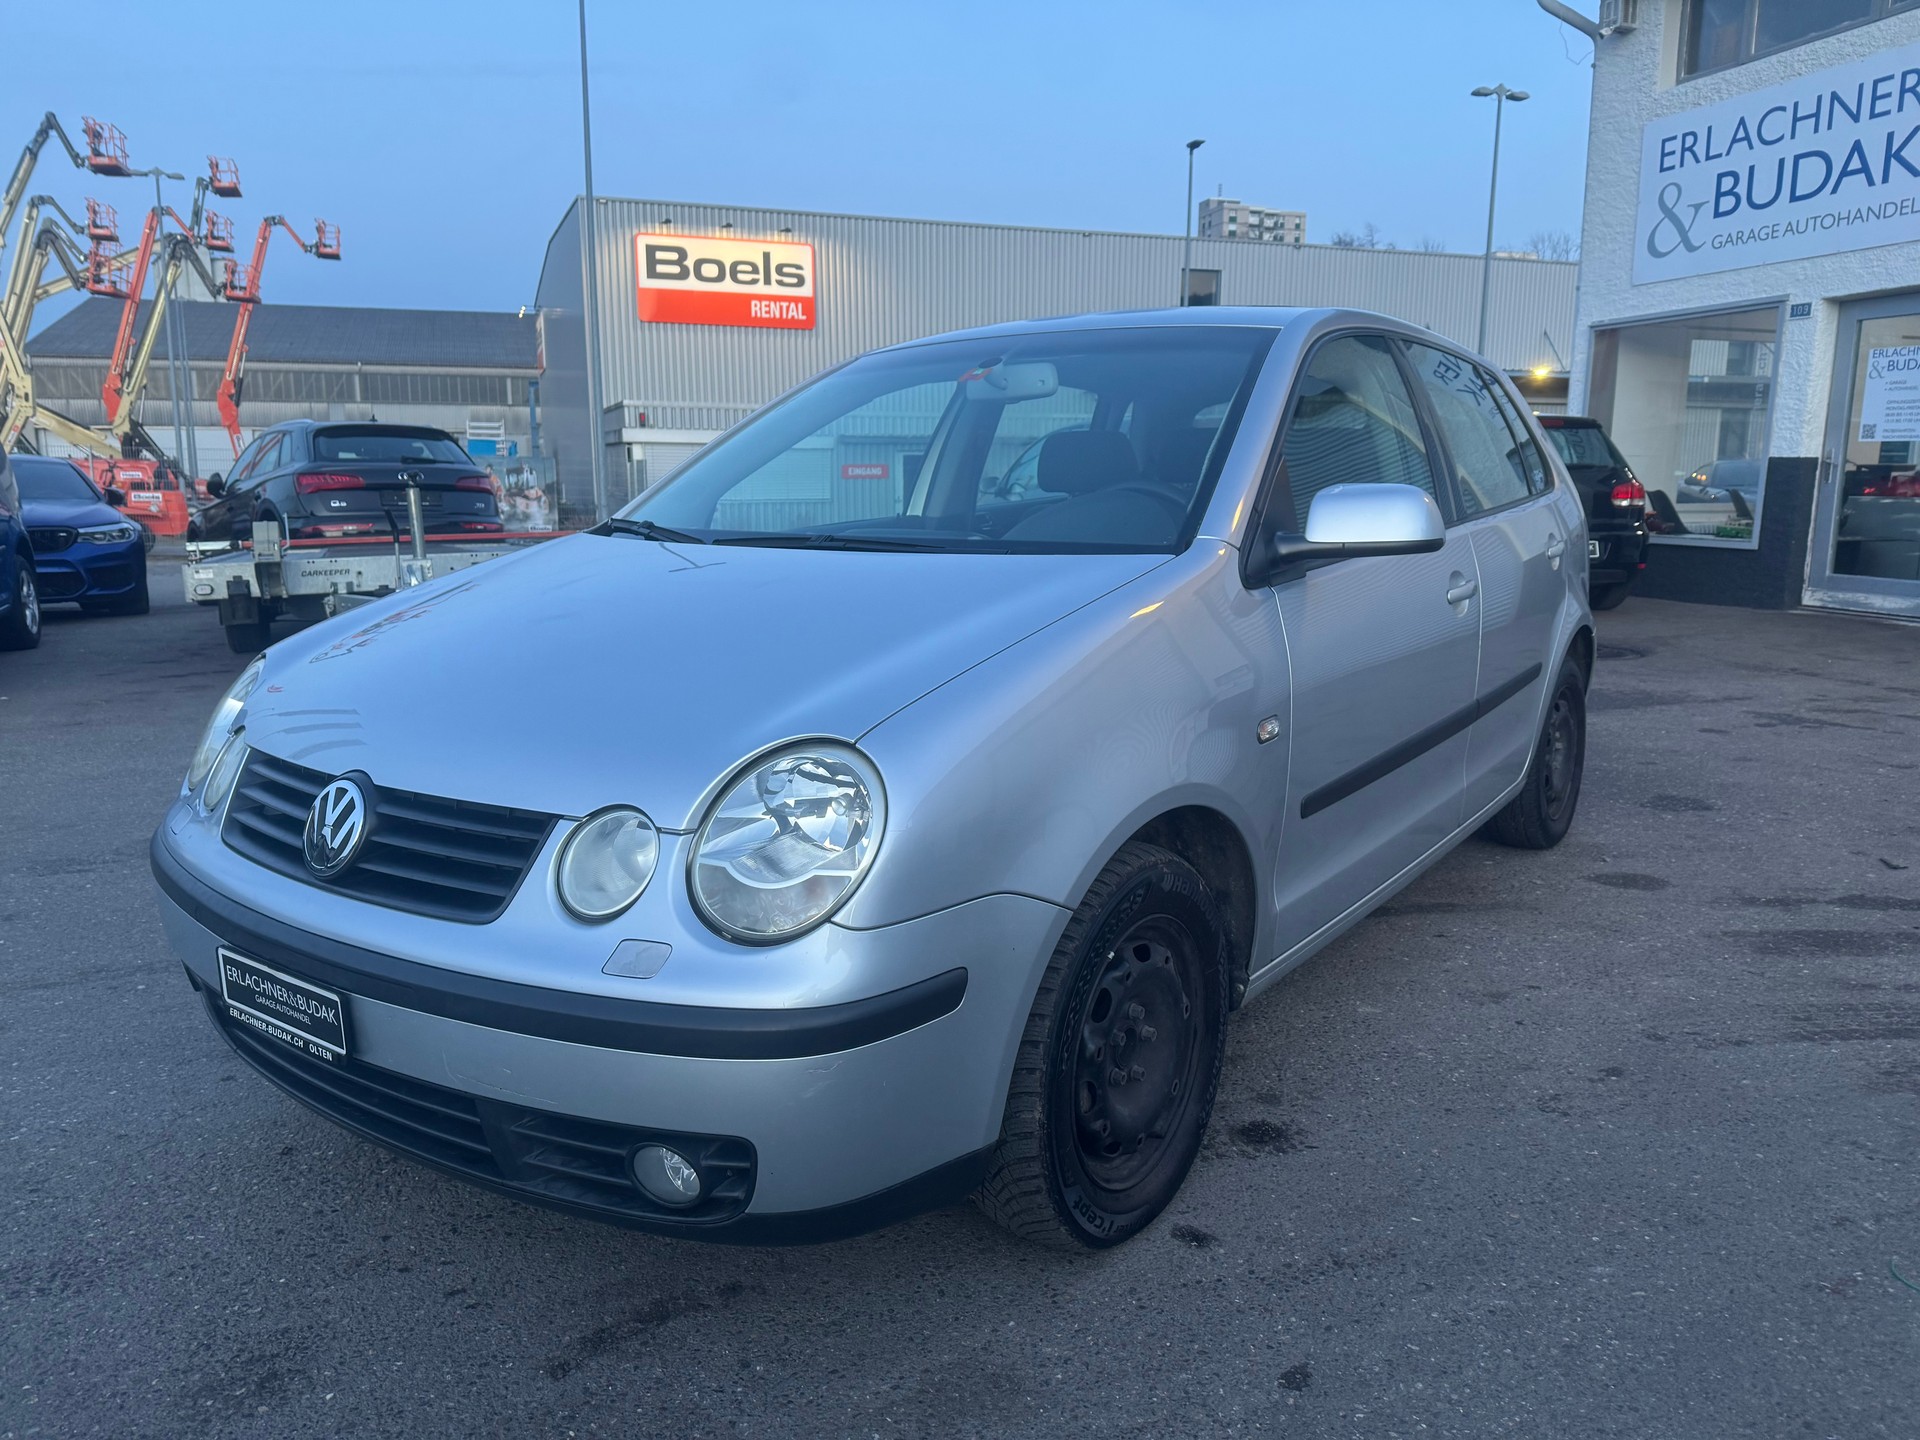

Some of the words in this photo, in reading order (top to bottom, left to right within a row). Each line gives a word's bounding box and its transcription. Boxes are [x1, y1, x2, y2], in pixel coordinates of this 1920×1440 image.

[1658, 67, 1920, 173] ERLACHNER
[1646, 182, 1710, 259] &
[1712, 124, 1920, 219] BUDAK
[1711, 223, 1780, 250] GARAGE
[1782, 198, 1920, 239] AUTOHANDEL
[645, 243, 806, 288] Boels
[751, 299, 807, 320] RENTAL
[1793, 304, 1809, 316] 109
[848, 466, 882, 476] EINGANG
[301, 568, 350, 578] CARKEEPER
[255, 994, 276, 1010] GARAGE
[229, 1007, 304, 1049] ERLACHNER-BUDAK.CH
[308, 1043, 333, 1062] OLTEN
